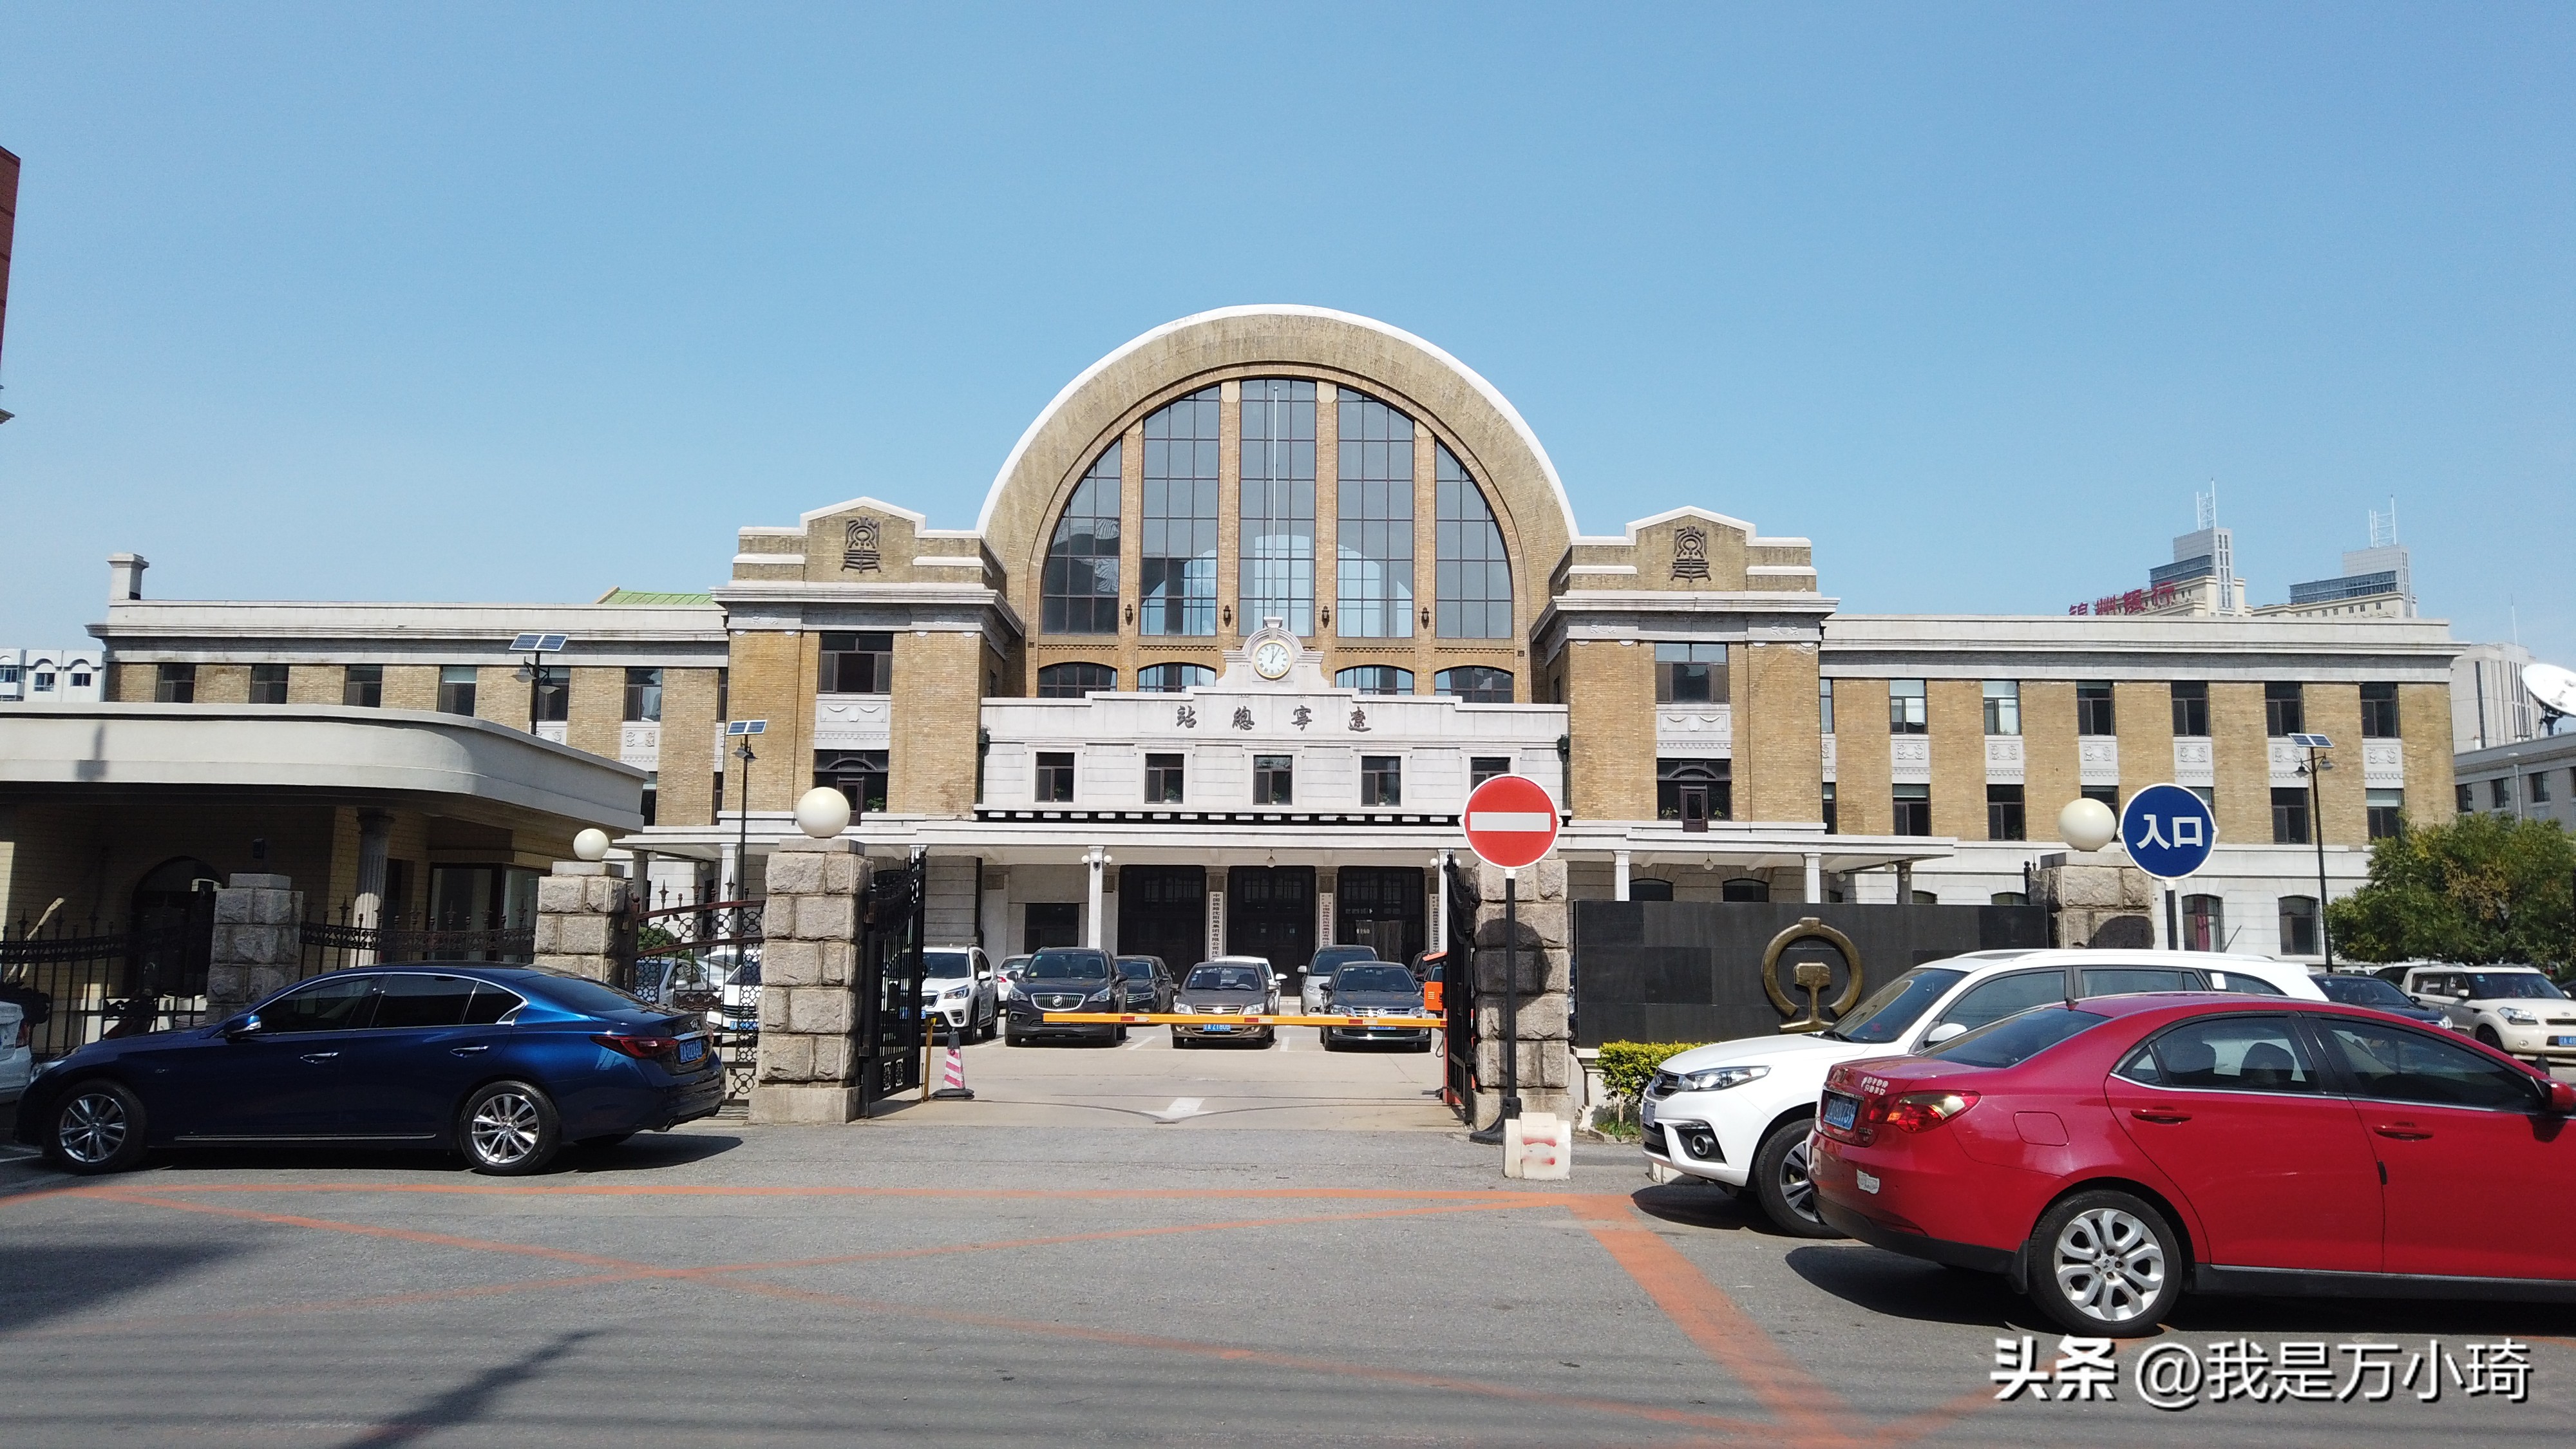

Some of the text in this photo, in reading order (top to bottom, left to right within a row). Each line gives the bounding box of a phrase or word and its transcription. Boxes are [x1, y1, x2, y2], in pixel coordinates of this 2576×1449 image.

[2136, 814, 2203, 850] 入口
[1211, 893, 1220, 958] 中国铁路沈阳局集团有限公司沈
